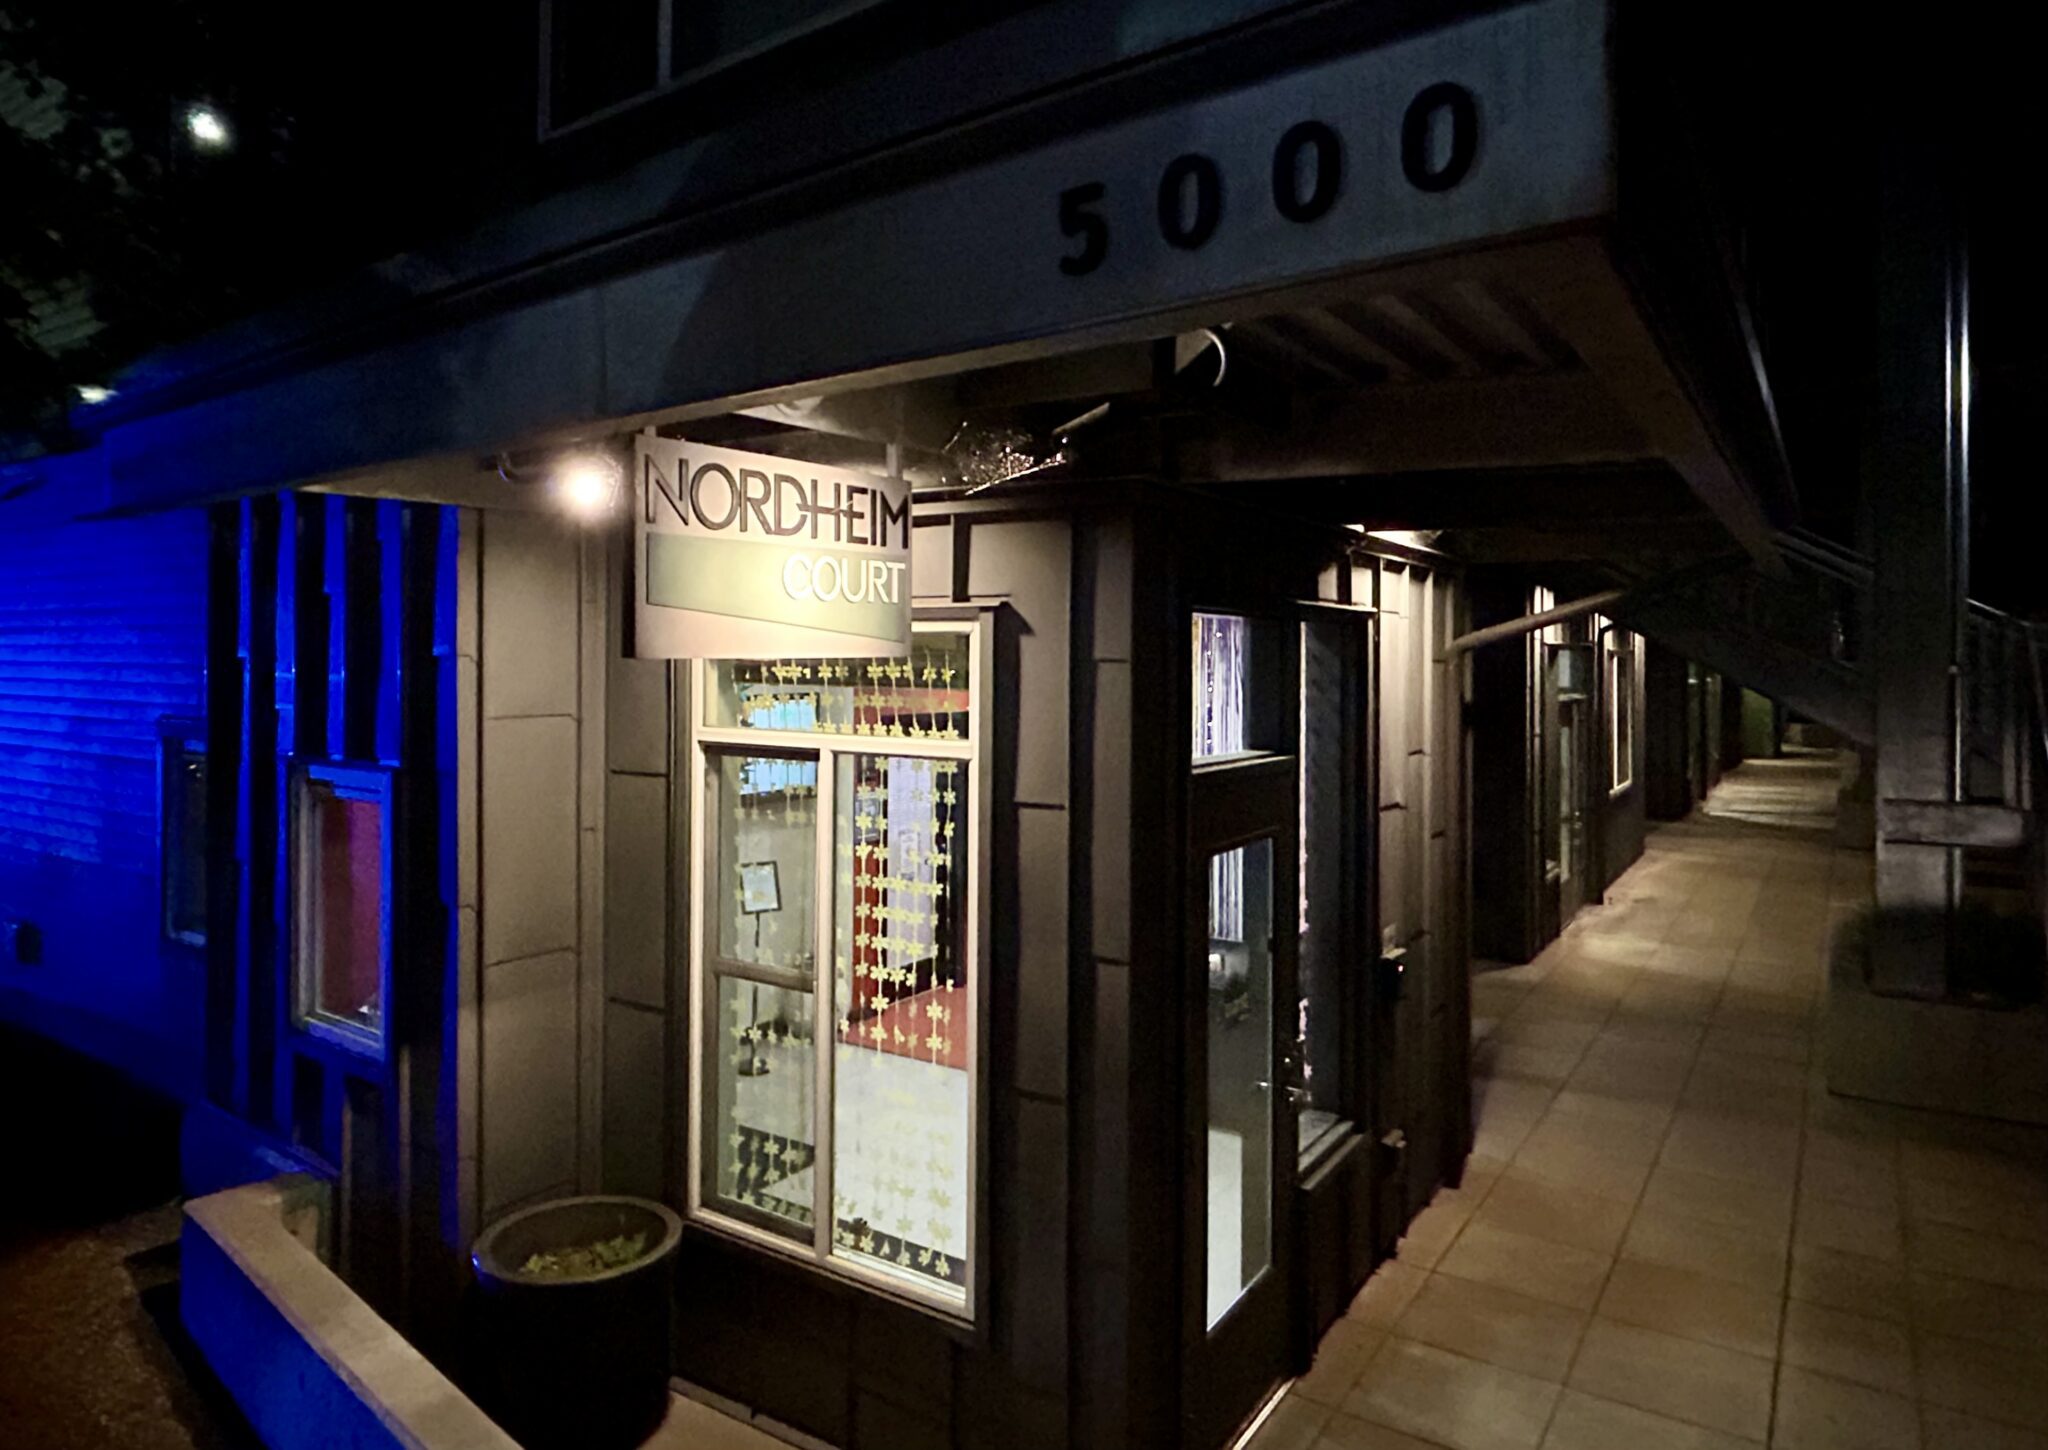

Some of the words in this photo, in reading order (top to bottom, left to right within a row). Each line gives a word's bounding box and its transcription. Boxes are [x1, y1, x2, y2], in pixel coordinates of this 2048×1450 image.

[1058, 81, 1478, 277] 5000
[644, 453, 909, 550] NORDHEIM
[783, 555, 906, 604] COURT
